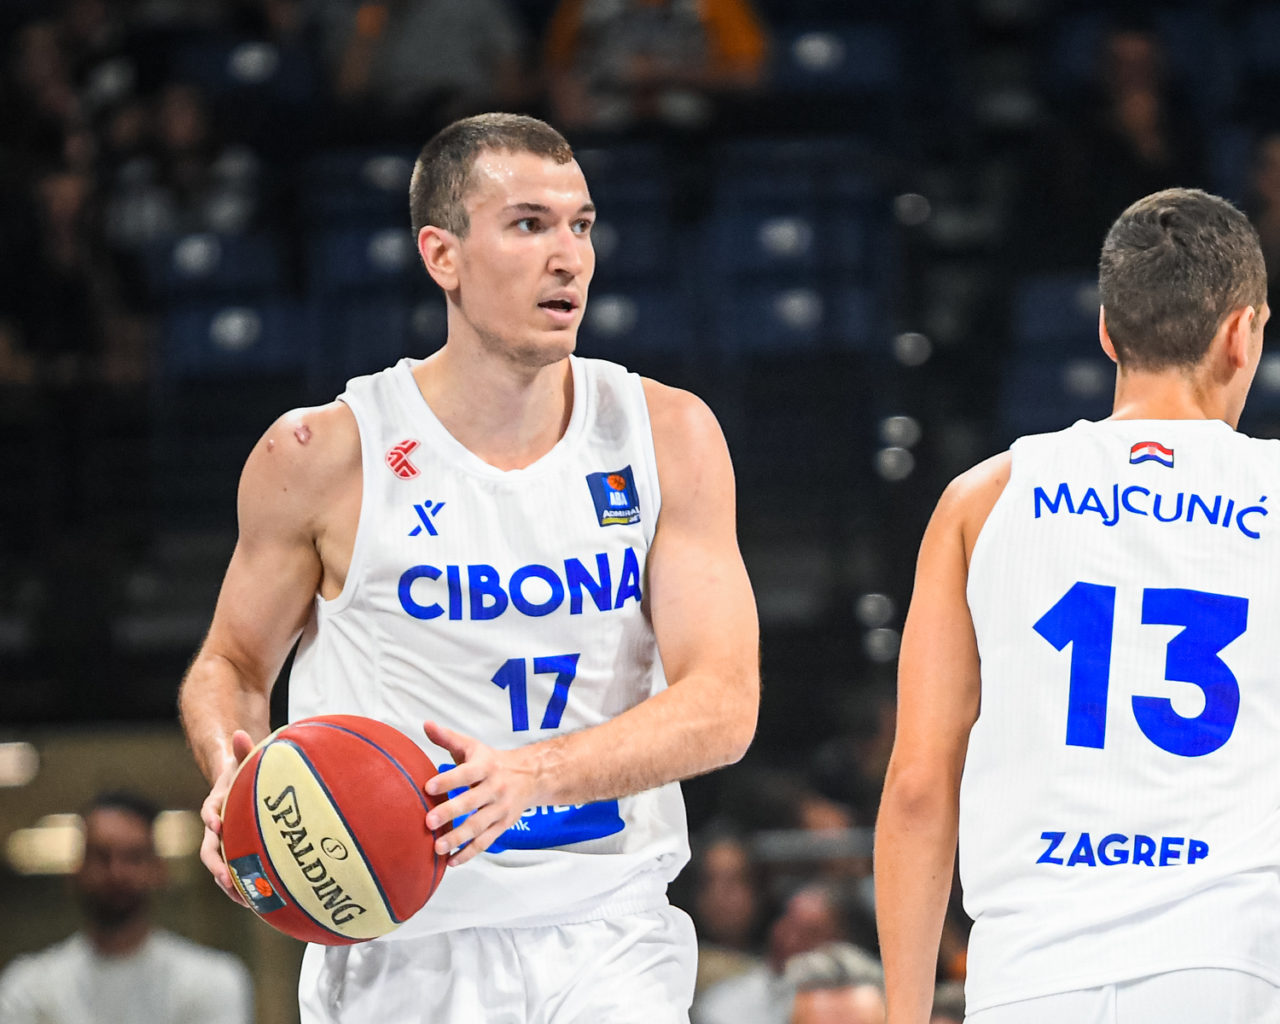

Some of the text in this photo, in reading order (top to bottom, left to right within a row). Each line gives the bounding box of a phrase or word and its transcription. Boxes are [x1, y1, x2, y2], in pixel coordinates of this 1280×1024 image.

[1033, 482, 1269, 539] MAJCUNIĆ
[397, 546, 642, 621] CIBONA
[491, 652, 581, 732] 17
[1032, 581, 1250, 757] 13
[263, 785, 367, 926] SPALDING
